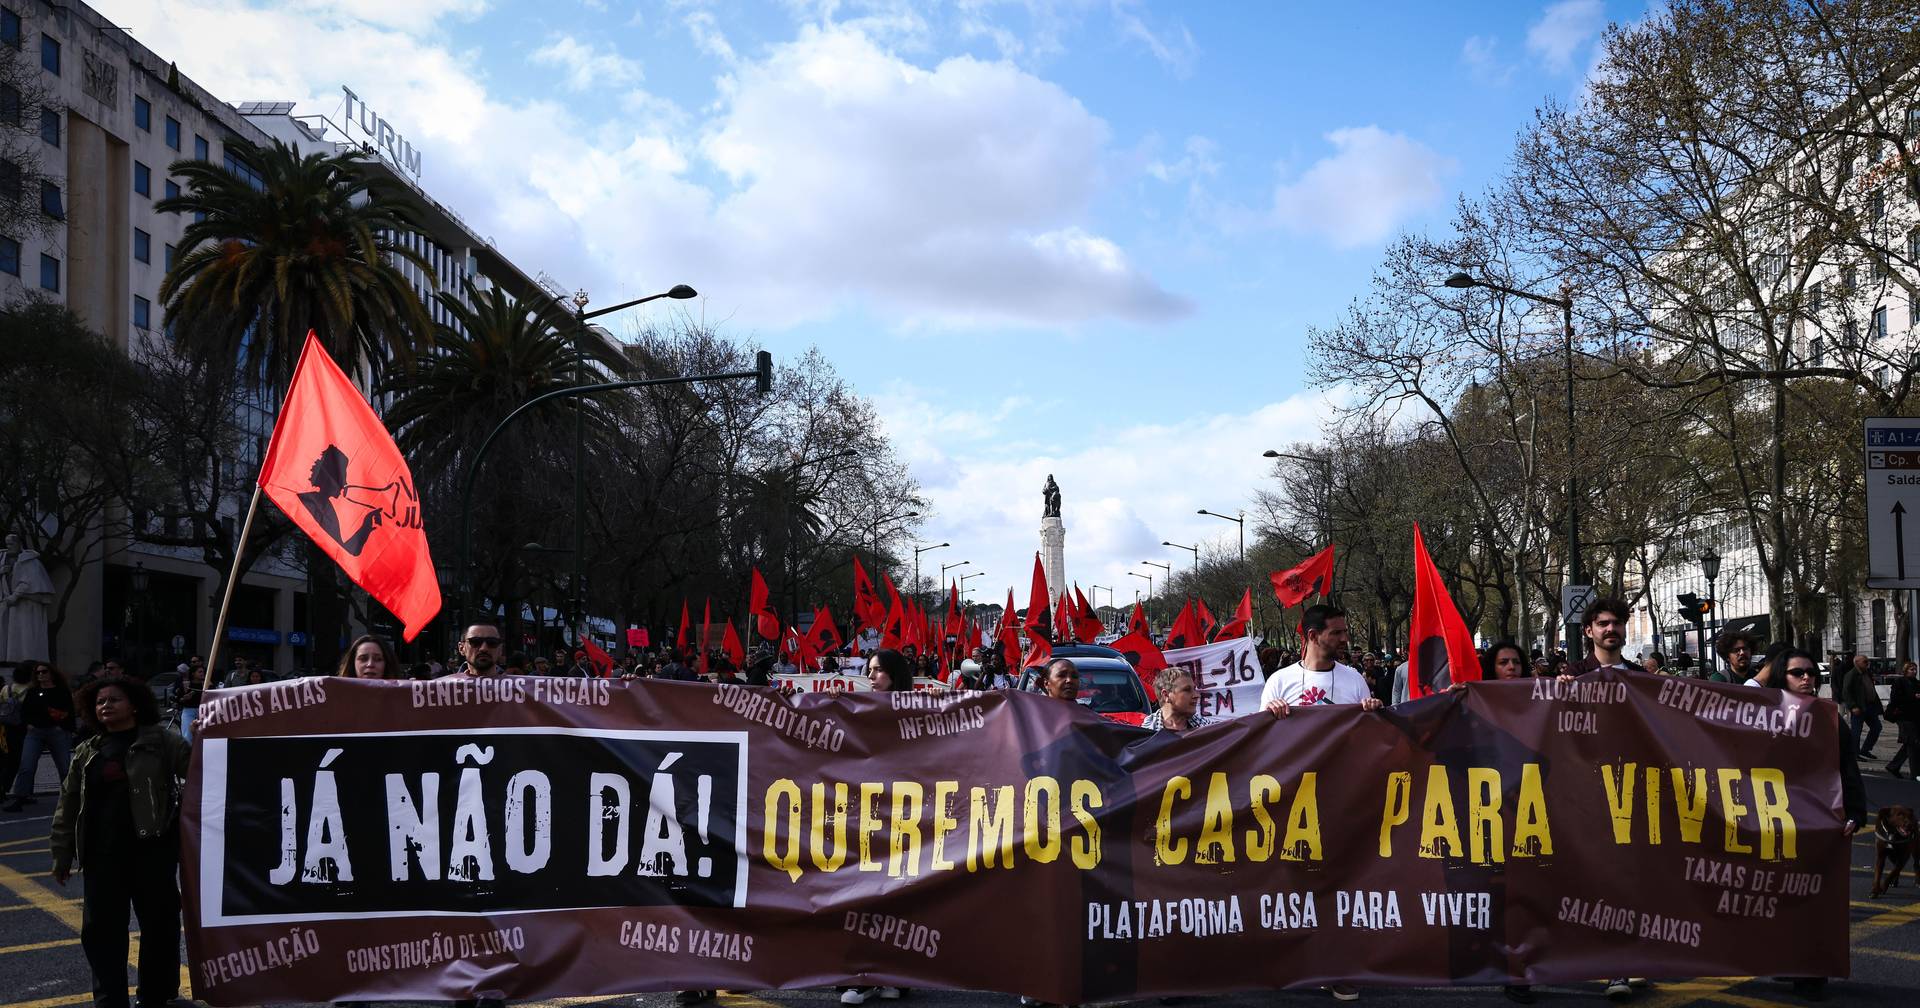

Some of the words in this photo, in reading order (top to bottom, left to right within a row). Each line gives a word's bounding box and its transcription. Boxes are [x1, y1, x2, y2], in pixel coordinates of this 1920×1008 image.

[342, 85, 421, 178] TURIM
[198, 690, 265, 729] RENDAS
[270, 678, 327, 714] ALTAS
[412, 678, 527, 709] BENEFÍCIOS
[534, 678, 611, 707] FISCAIS
[1531, 677, 1627, 705] ALOJAMENTO
[1657, 678, 1813, 739] GENTRIFICAÇÃO
[712, 683, 845, 752] SOBRELOTAÇÃO
[898, 705, 985, 740] INFORMAIS
[1558, 710, 1598, 735] LOCAL
[269, 747, 354, 886] JÁ
[385, 742, 552, 882] NÃO
[587, 751, 712, 878] DÁ!
[762, 775, 1103, 883] QUEREMOS
[1155, 771, 1323, 868] CASA
[1378, 762, 1554, 866] PARA
[1600, 758, 1798, 862] VIVER
[1683, 856, 1746, 890] TAXAS
[1751, 870, 1775, 894] DE
[1778, 872, 1822, 896] JURO
[1088, 894, 1244, 941] PLATAFORMA
[1260, 891, 1318, 931] CASA
[1336, 889, 1402, 930] PARA
[1421, 890, 1491, 930] VIVER
[1558, 896, 1635, 937] SALÁRIOS
[1638, 907, 1702, 948] BAIXOS
[1716, 890, 1778, 919] ALTAS
[200, 926, 321, 989] SPECULAÇÃO
[346, 930, 456, 974] CONSTRUÇÃO
[458, 934, 478, 960] DE
[479, 925, 526, 957] LUXO
[619, 919, 680, 954] CASAS
[688, 928, 754, 963] VAZIAS
[843, 910, 942, 959] DESPEJOS
